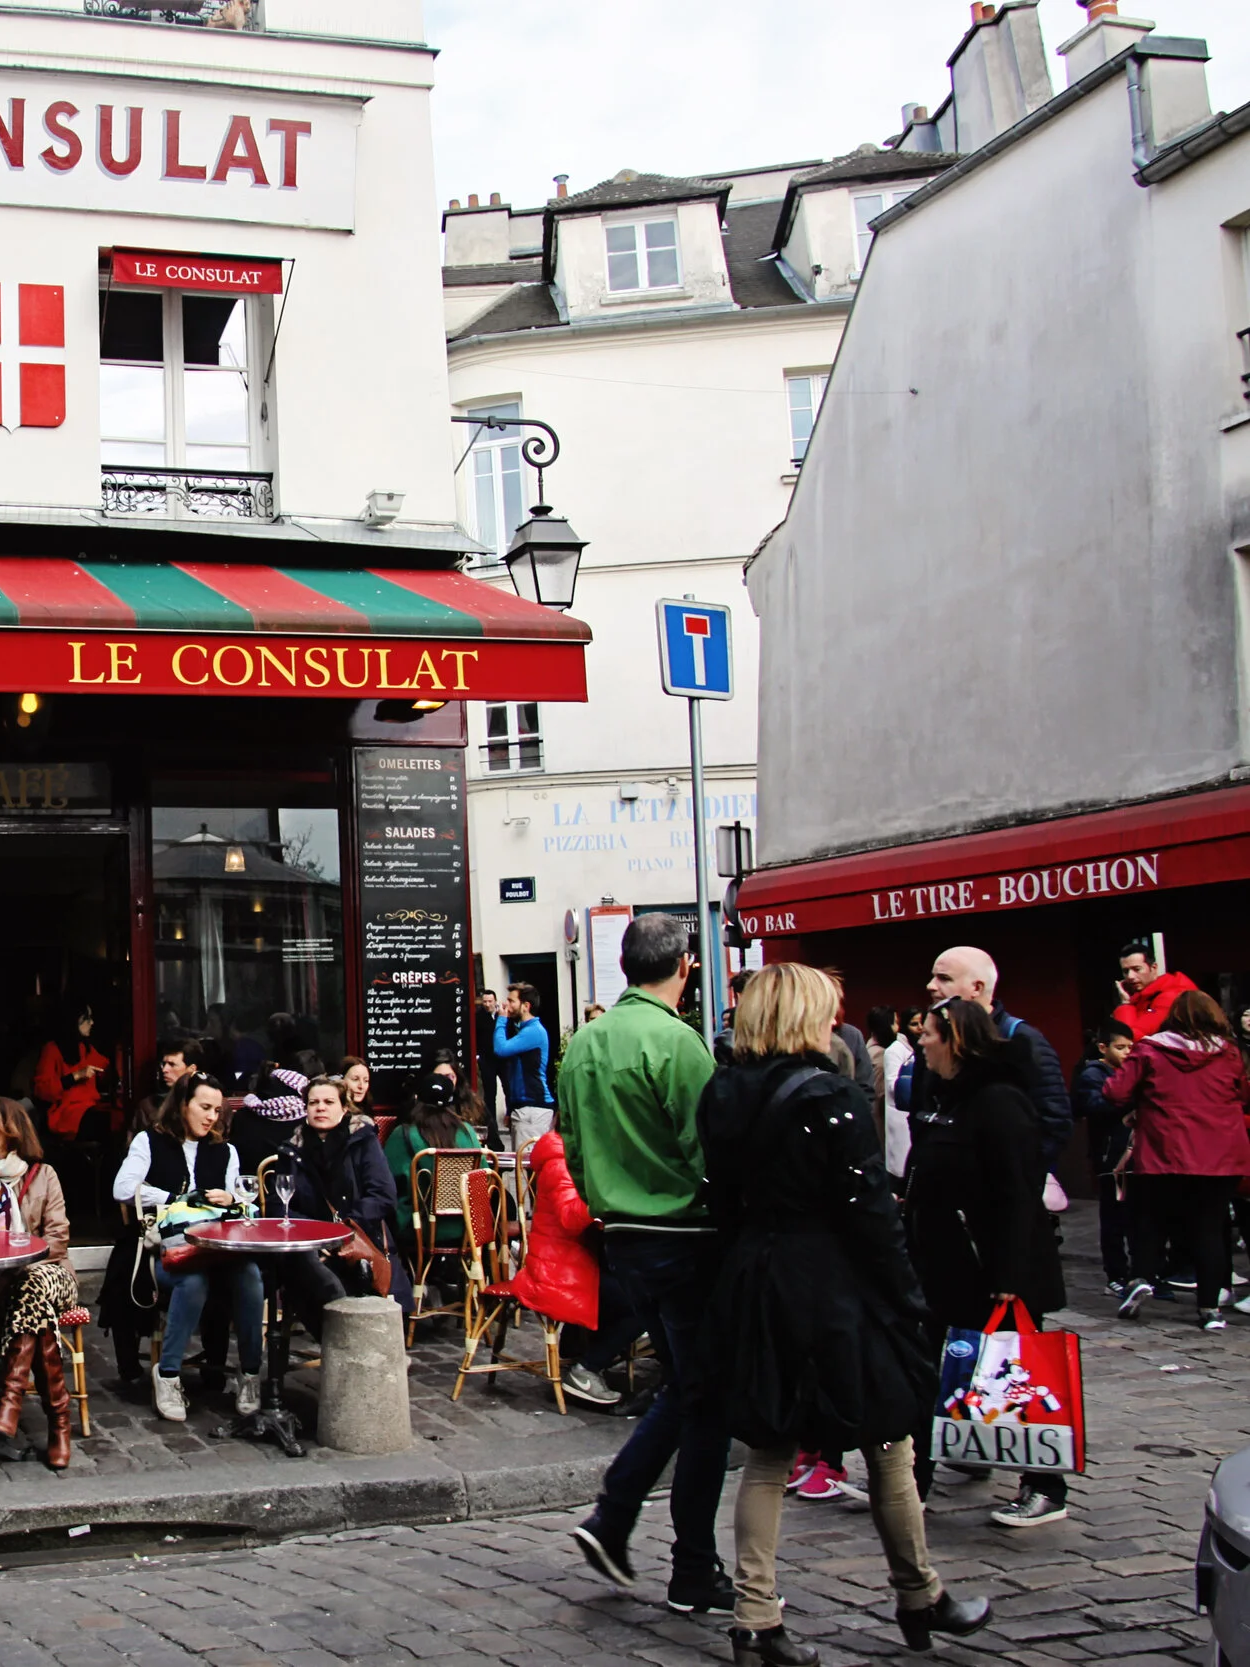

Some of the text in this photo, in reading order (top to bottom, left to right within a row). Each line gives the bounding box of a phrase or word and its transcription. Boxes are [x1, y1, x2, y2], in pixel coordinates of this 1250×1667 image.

[135, 262, 262, 285] LE CONSULAT
[68, 642, 142, 684] LE
[171, 644, 479, 691] CONSULAT
[379, 759, 441, 770] OMELETTES
[553, 802, 590, 826] LA
[385, 827, 436, 838] SALADES
[543, 834, 628, 853] PIZZERIA
[628, 857, 673, 872] PIANO
[872, 891, 905, 920] LE
[910, 881, 976, 915] TIRE
[998, 854, 1159, 905] BOUCHON
[765, 913, 795, 932] BAR
[392, 971, 436, 984] CRÊPES
[940, 1421, 1061, 1467] PARIS
